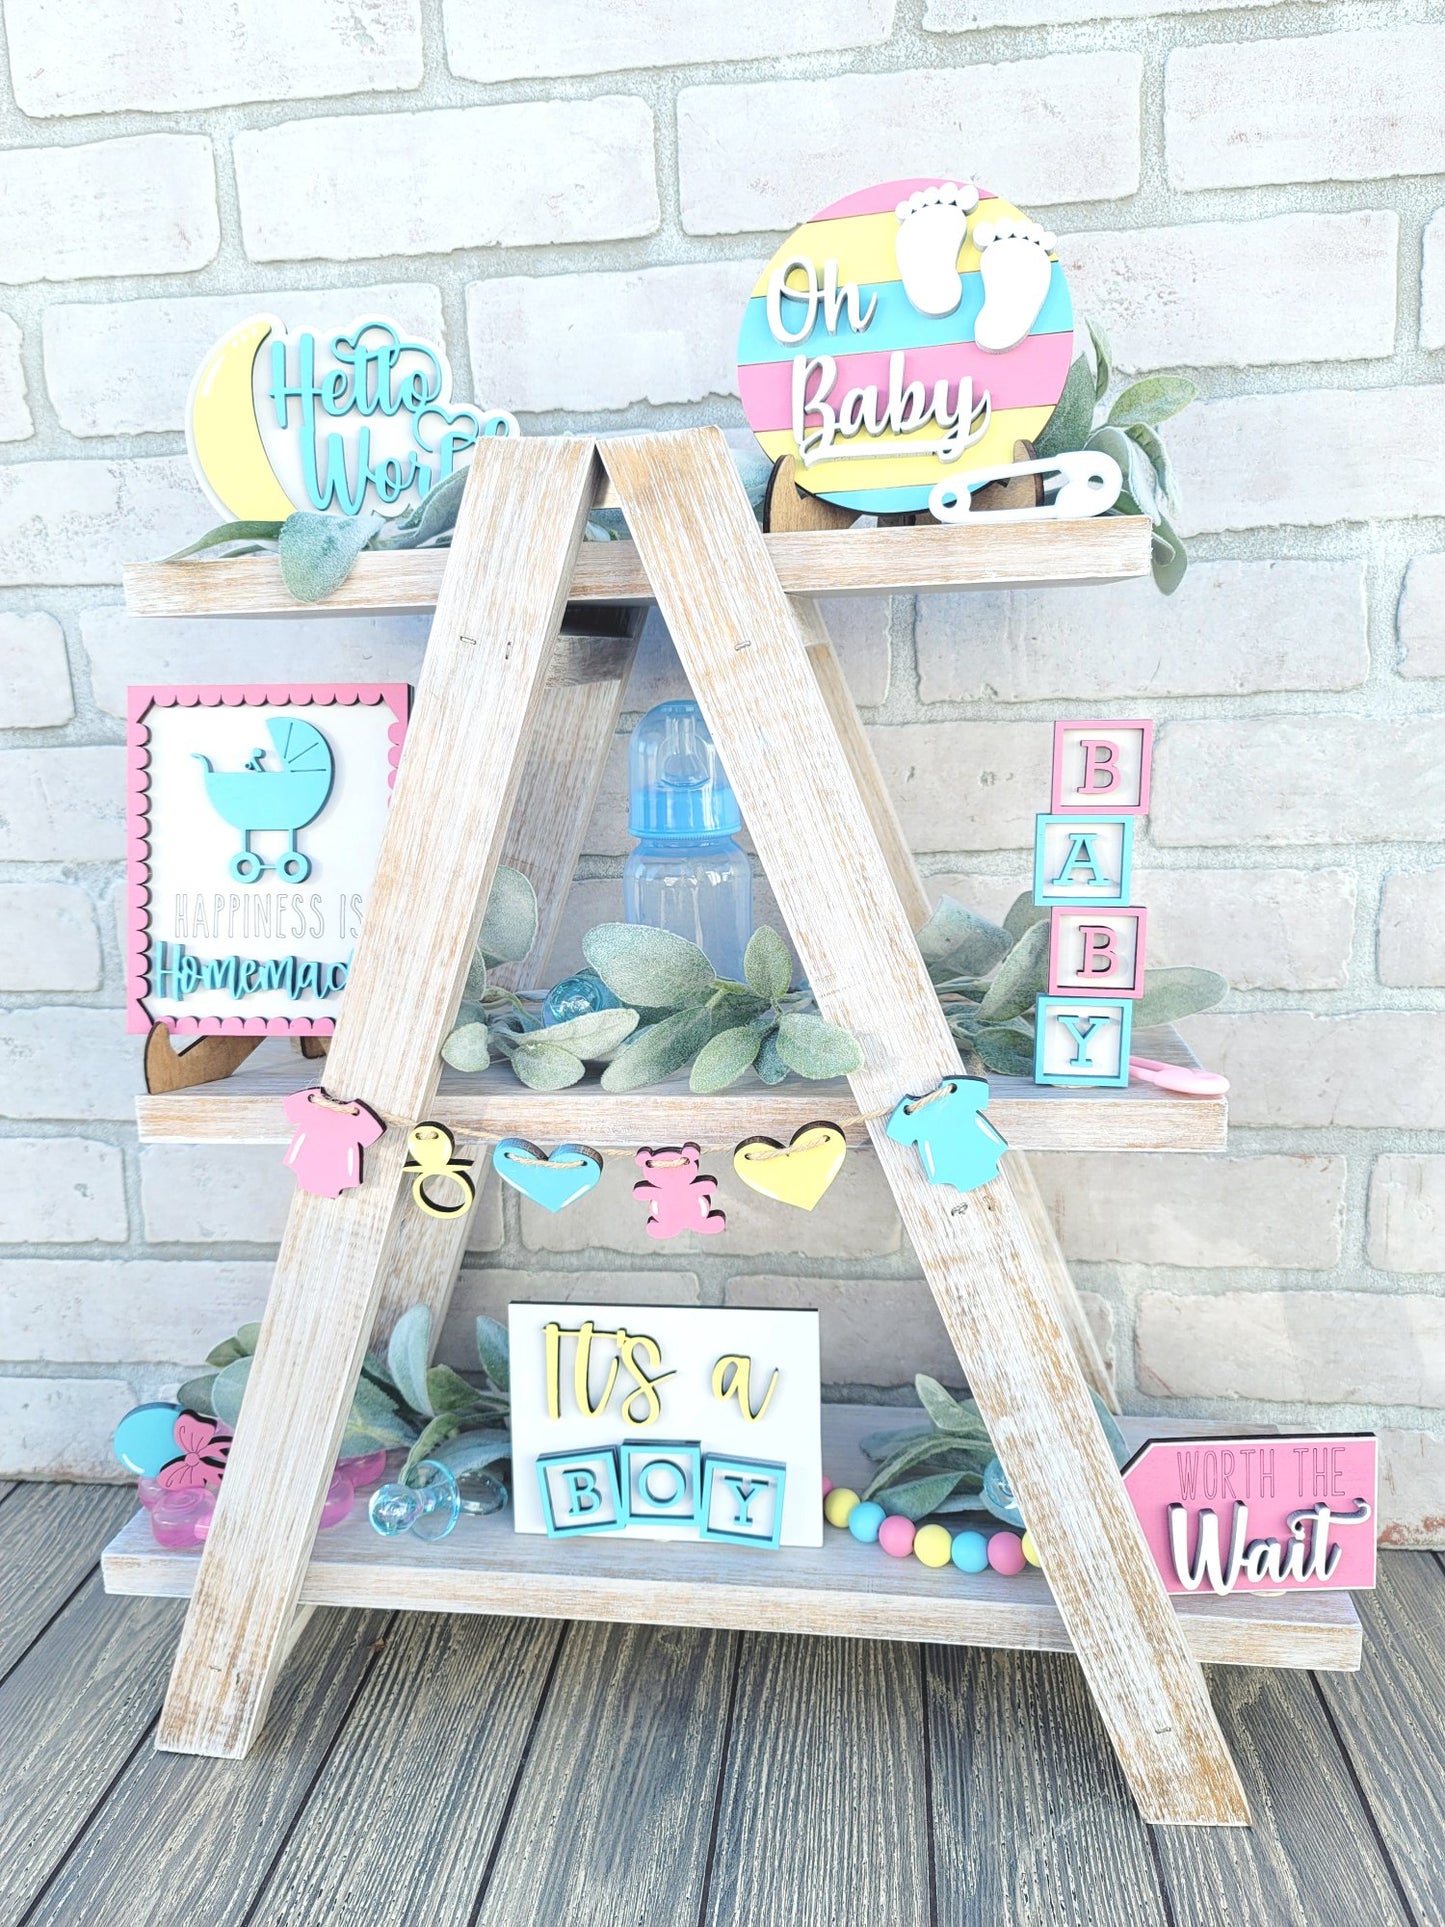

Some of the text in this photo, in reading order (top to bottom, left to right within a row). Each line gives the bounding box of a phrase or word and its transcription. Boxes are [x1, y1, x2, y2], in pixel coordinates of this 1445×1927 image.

[765, 255, 879, 348] Oh
[269, 321, 442, 429] Hello
[790, 350, 992, 470] Baby
[299, 405, 510, 516] Worl
[174, 893, 364, 940] HAPPINESS IS
[711, 1353, 779, 1421] a
[560, 1458, 770, 1528] BOY
[1176, 1446, 1346, 1501] WORTH THE
[1167, 1497, 1372, 1596] Wait
